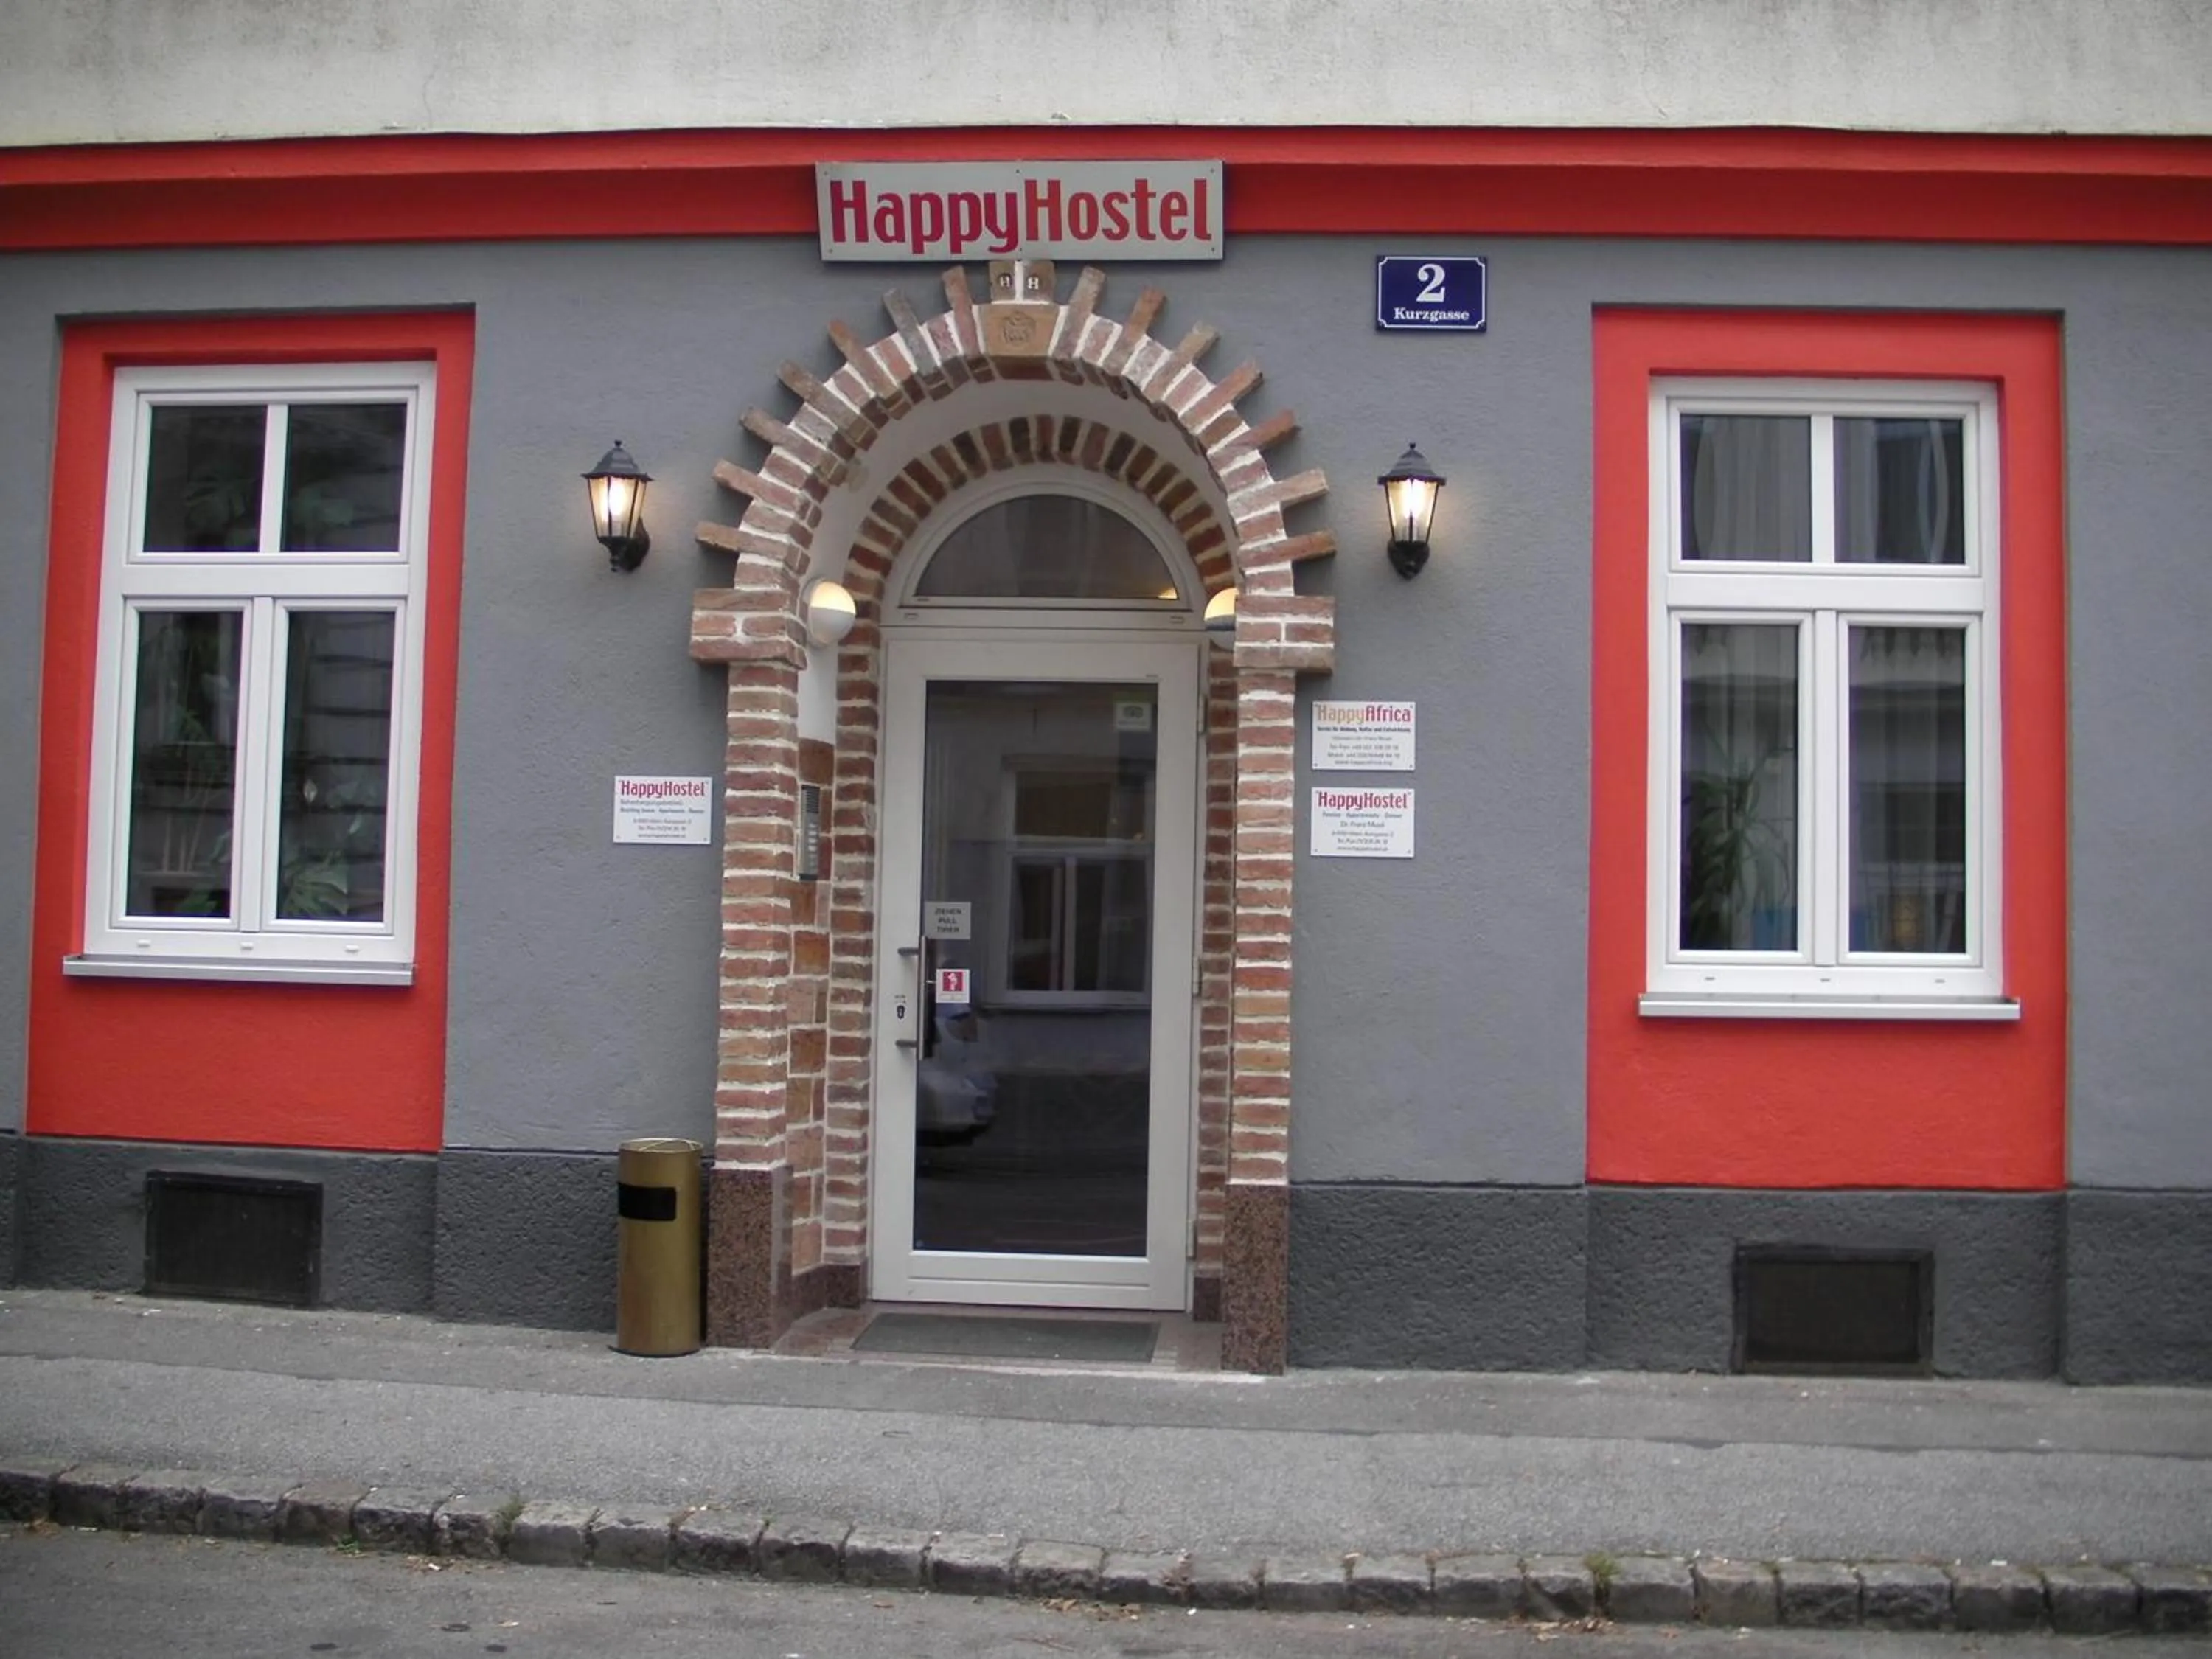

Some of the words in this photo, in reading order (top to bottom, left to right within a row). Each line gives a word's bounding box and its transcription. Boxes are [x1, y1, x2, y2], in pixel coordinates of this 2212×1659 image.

[830, 178, 1212, 254] HappyHostel
[1416, 263, 1445, 302] 2
[1394, 307, 1470, 322] Kurzgasse
[1317, 704, 1411, 724] HappyAfrica
[620, 780, 705, 798] HappyHostel
[1318, 791, 1408, 810] HappyHostel
